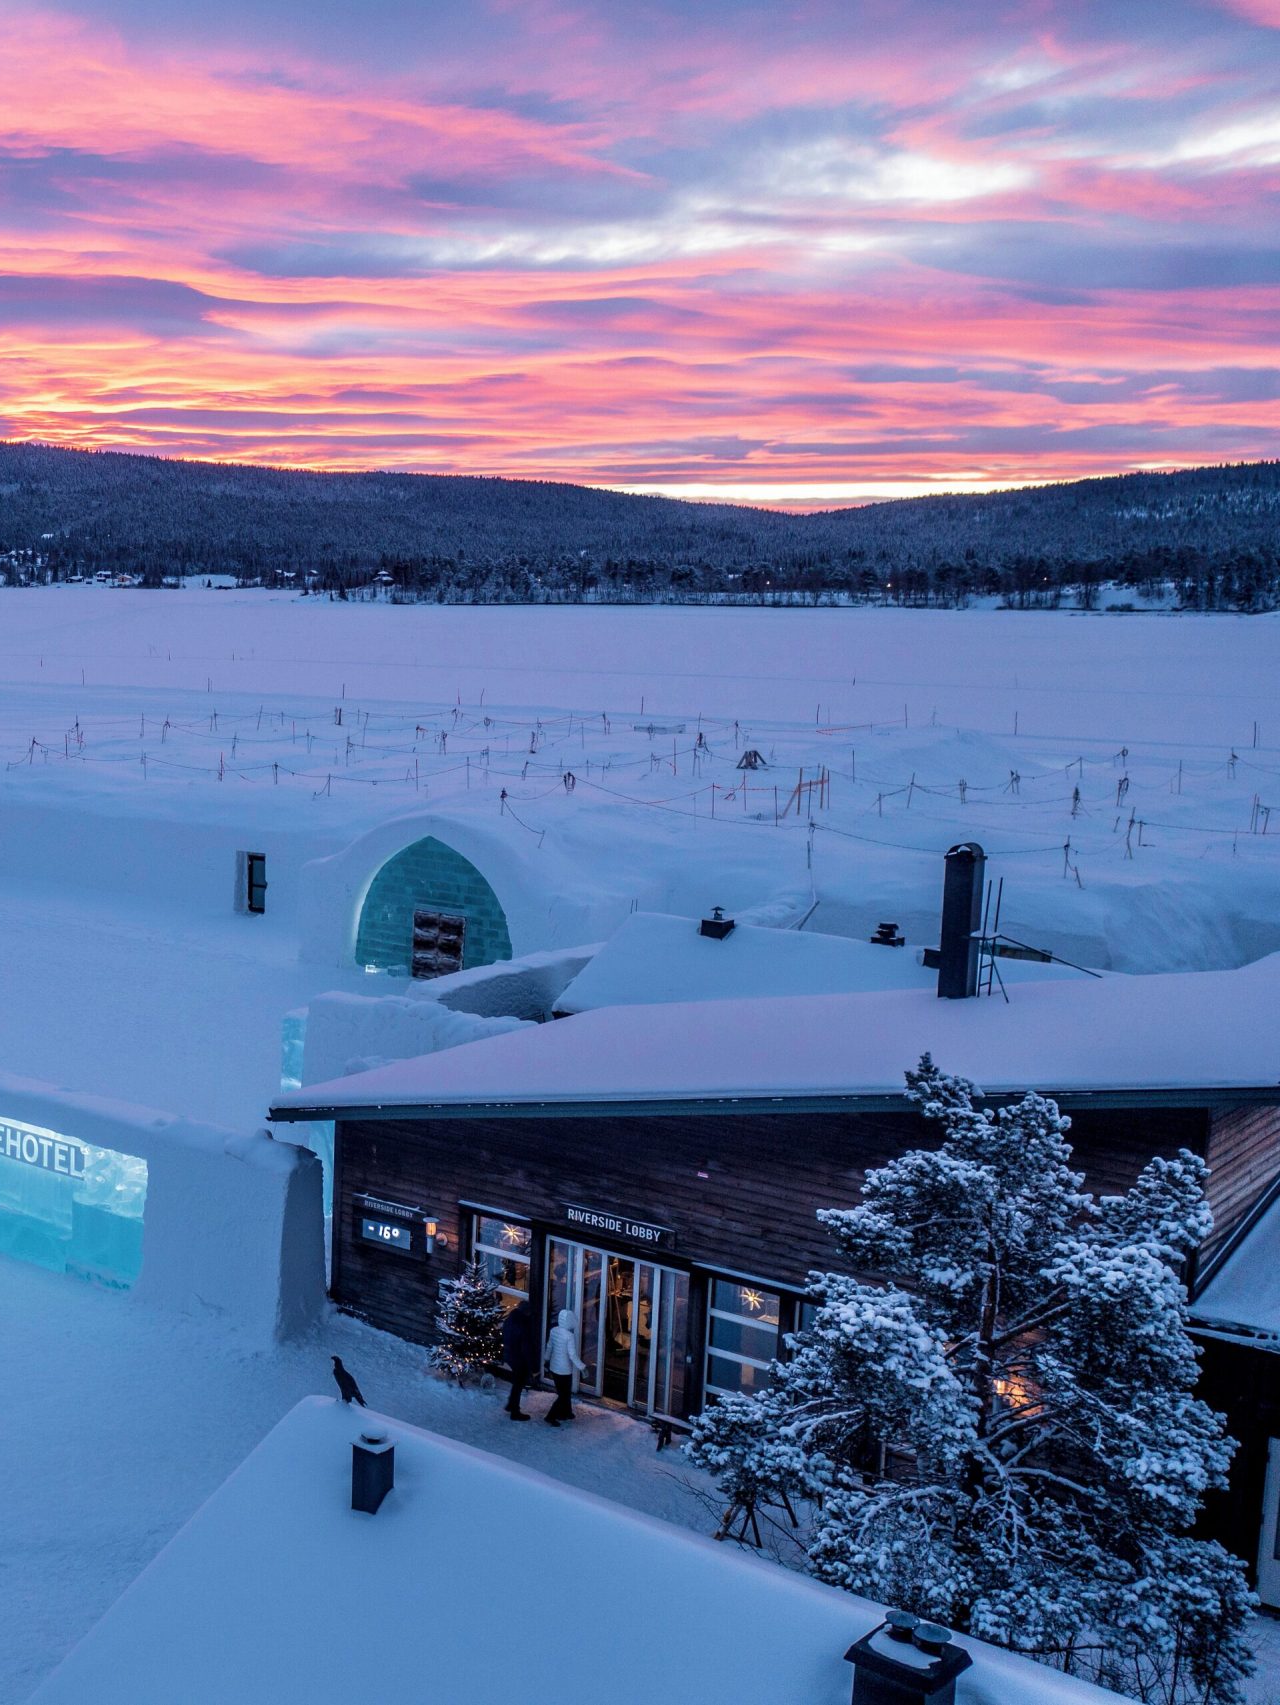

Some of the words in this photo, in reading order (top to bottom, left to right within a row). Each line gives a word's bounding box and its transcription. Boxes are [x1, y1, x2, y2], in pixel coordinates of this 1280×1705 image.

[364, 1199, 394, 1214] RIVERSIDE
[394, 1208, 413, 1218] LOBBY
[567, 1208, 622, 1233] RIVERSIDE
[625, 1223, 661, 1242] LOBBY
